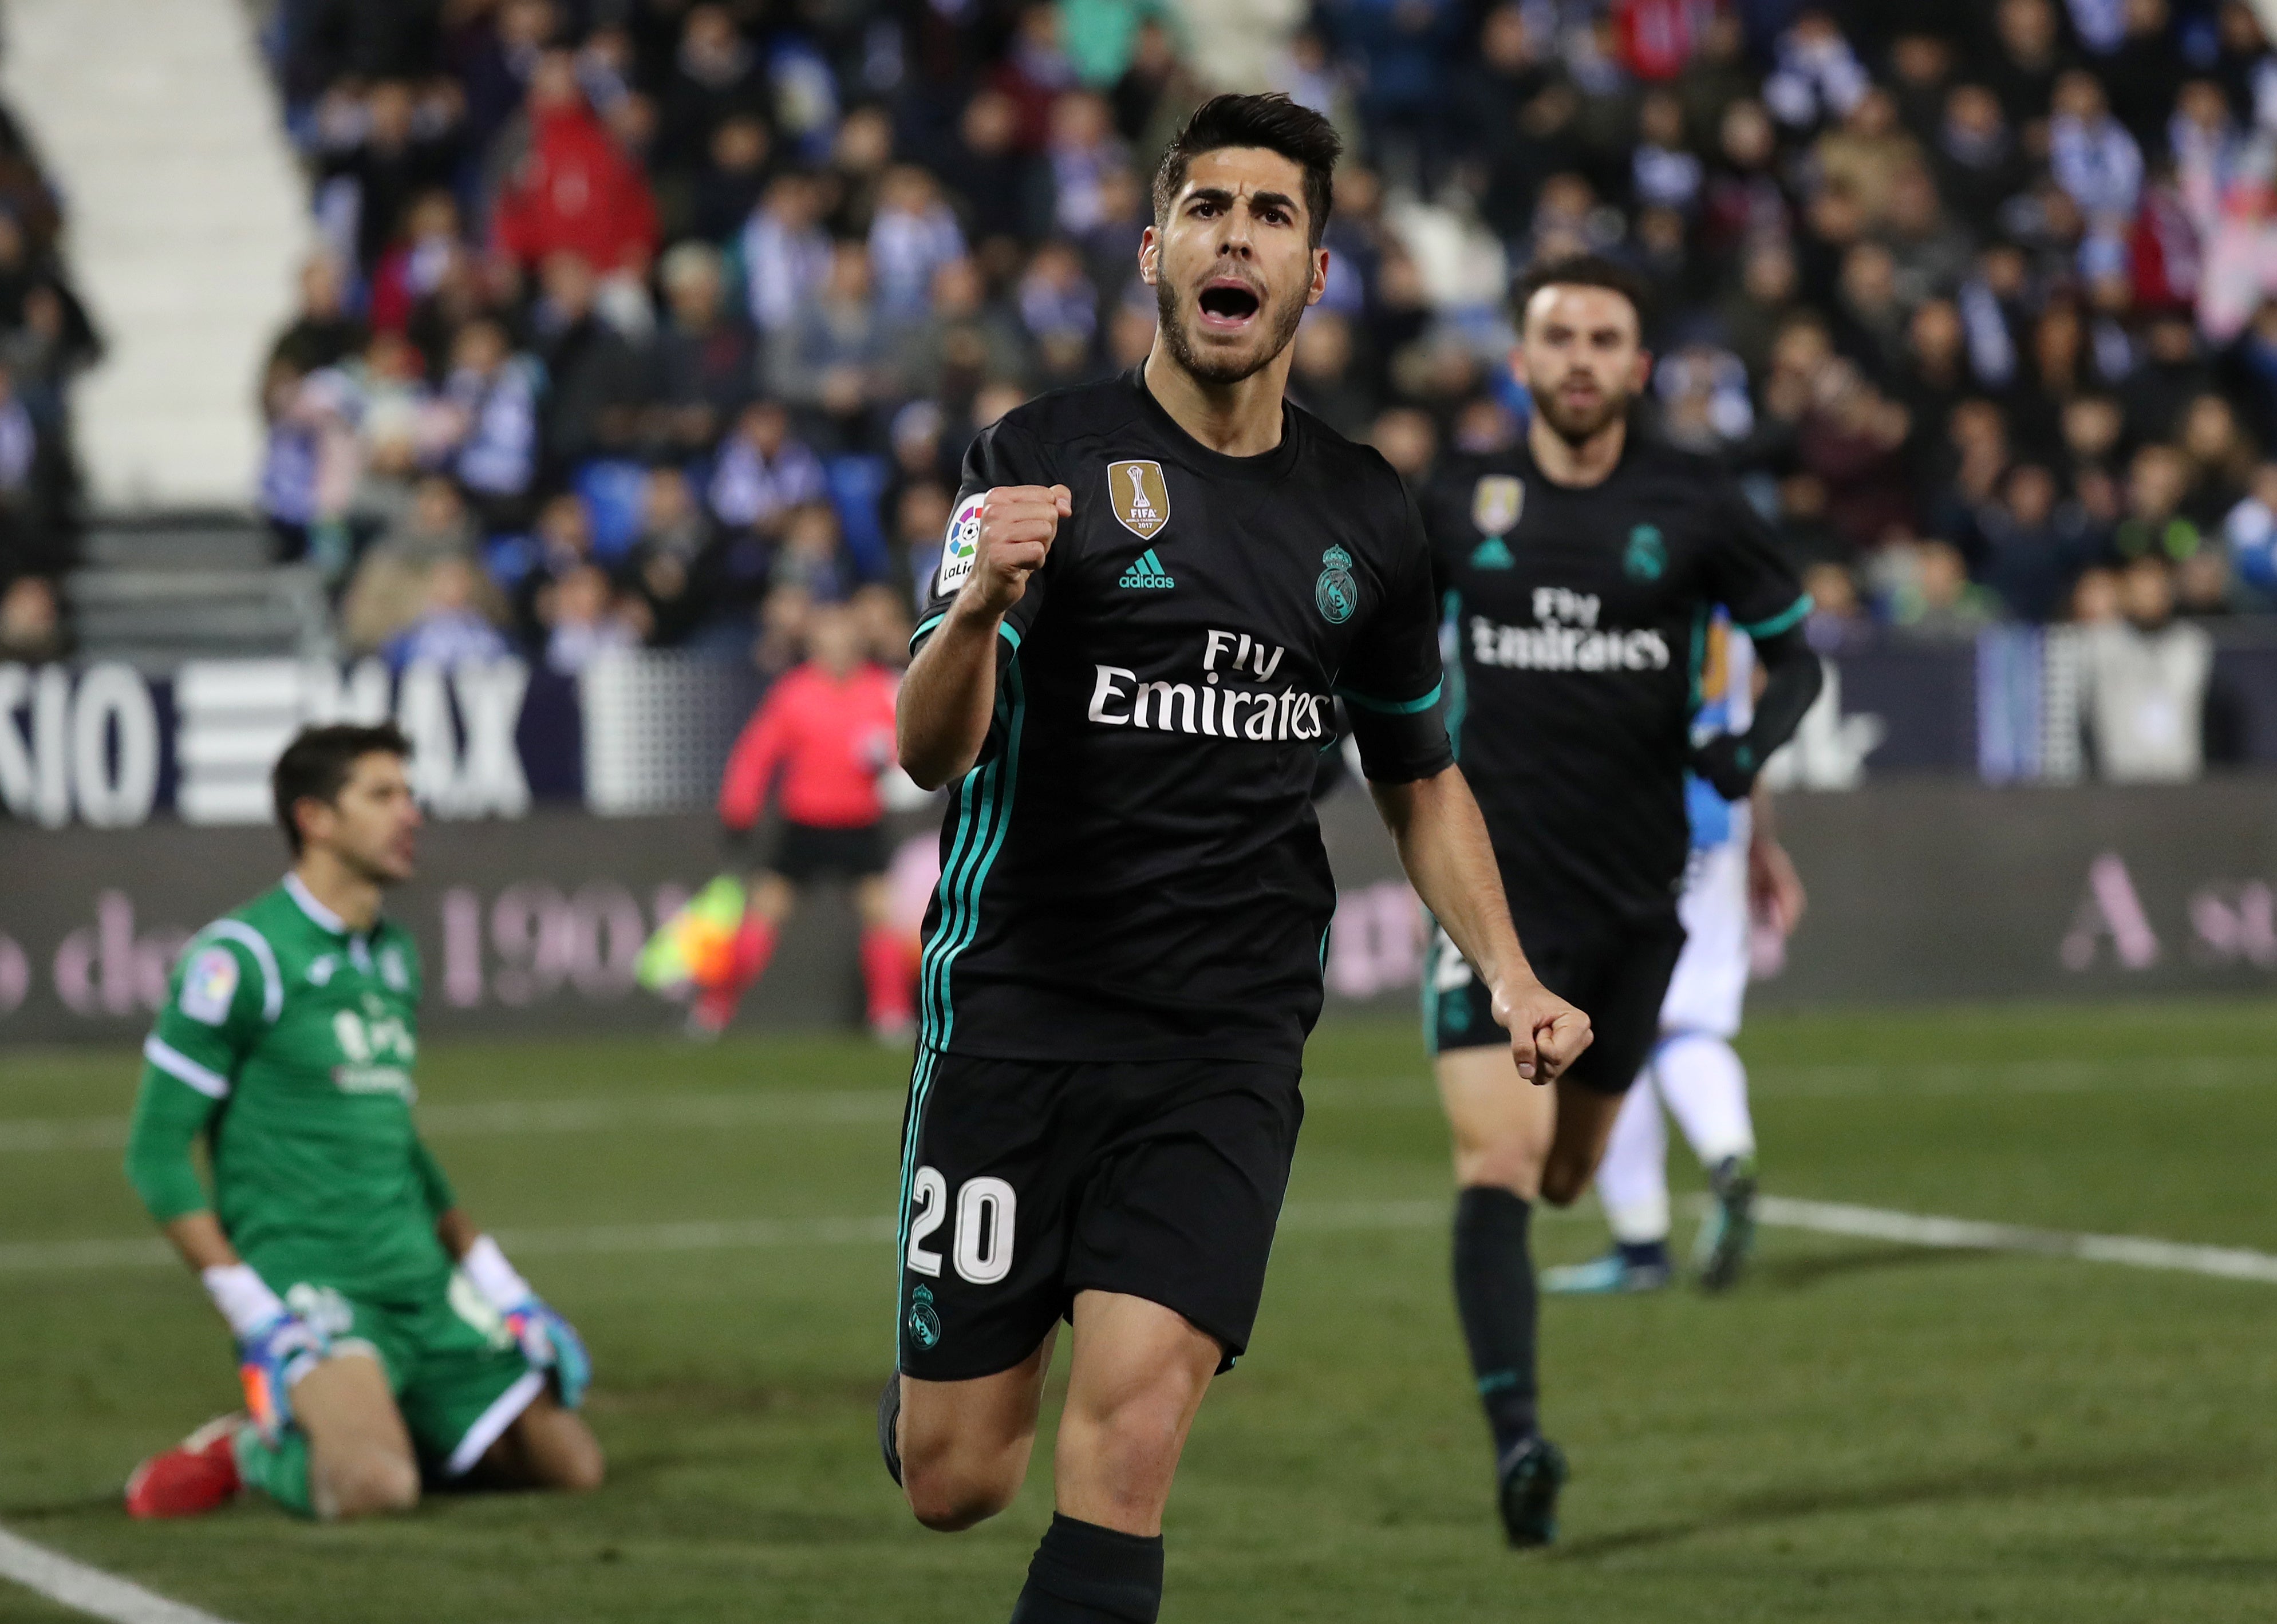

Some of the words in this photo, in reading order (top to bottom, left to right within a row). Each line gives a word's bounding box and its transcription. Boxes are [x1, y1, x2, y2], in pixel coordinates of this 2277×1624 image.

[1130, 508, 1157, 518] FIFA
[1119, 573, 1175, 589] adidas
[1203, 629, 1285, 683] Fly
[1088, 664, 1331, 741] Emirates
[906, 1164, 1017, 1285] 20
